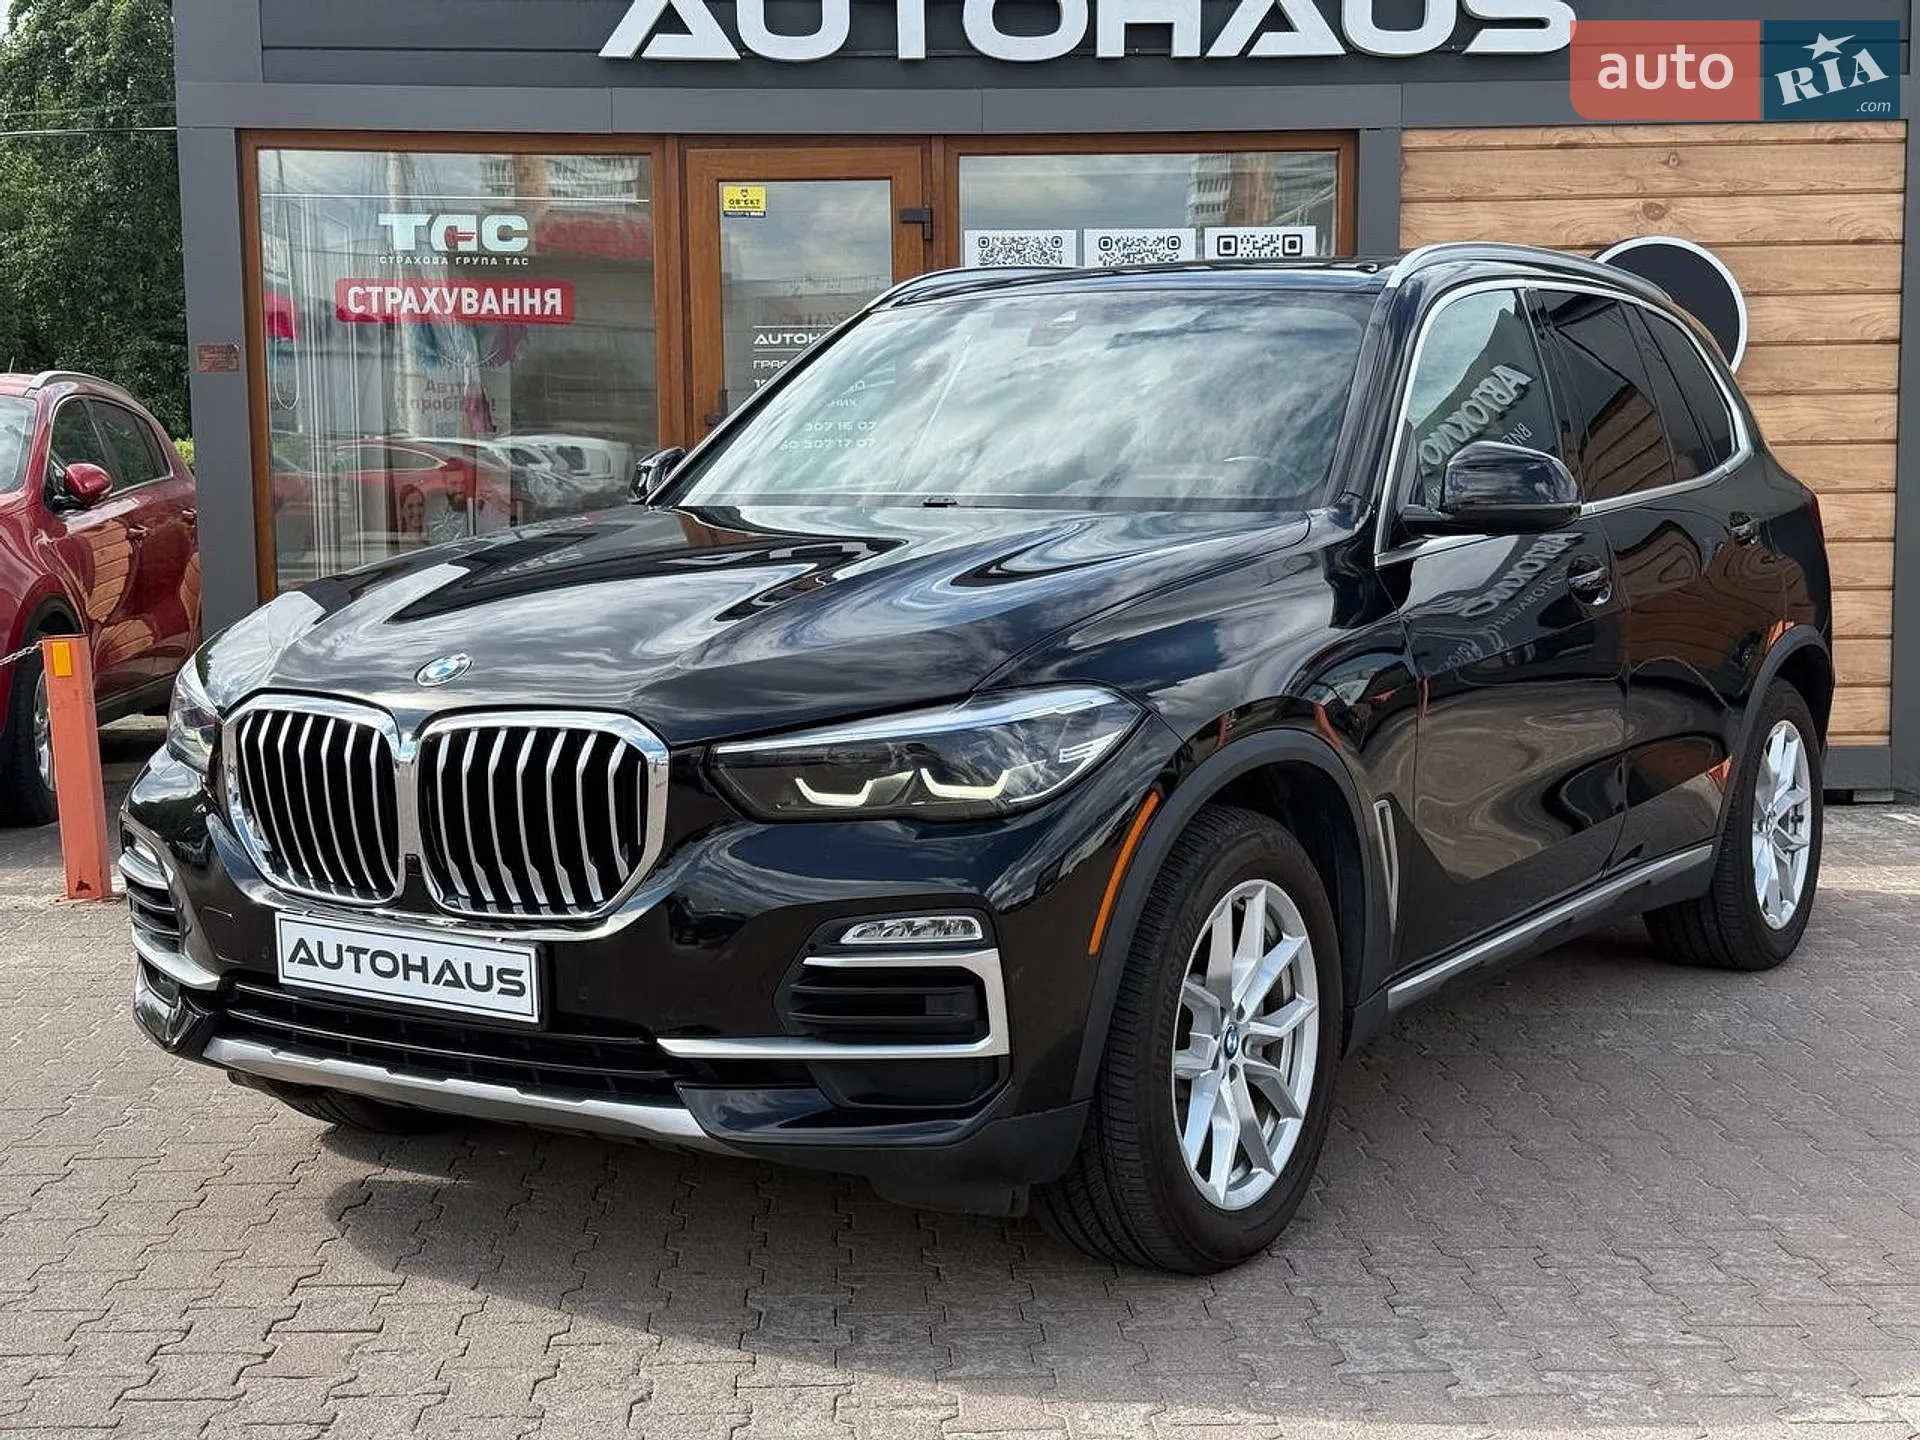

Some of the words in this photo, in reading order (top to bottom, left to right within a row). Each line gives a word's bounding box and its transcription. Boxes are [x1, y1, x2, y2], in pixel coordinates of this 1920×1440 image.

[378, 214, 529, 252] ТАС
[455, 257, 498, 265] ГРУПА
[505, 257, 529, 265] ТАС
[347, 286, 563, 316] СТРАХУВАННЯ
[754, 333, 820, 344] AUTOH
[287, 937, 527, 998] AUTOHAUS
